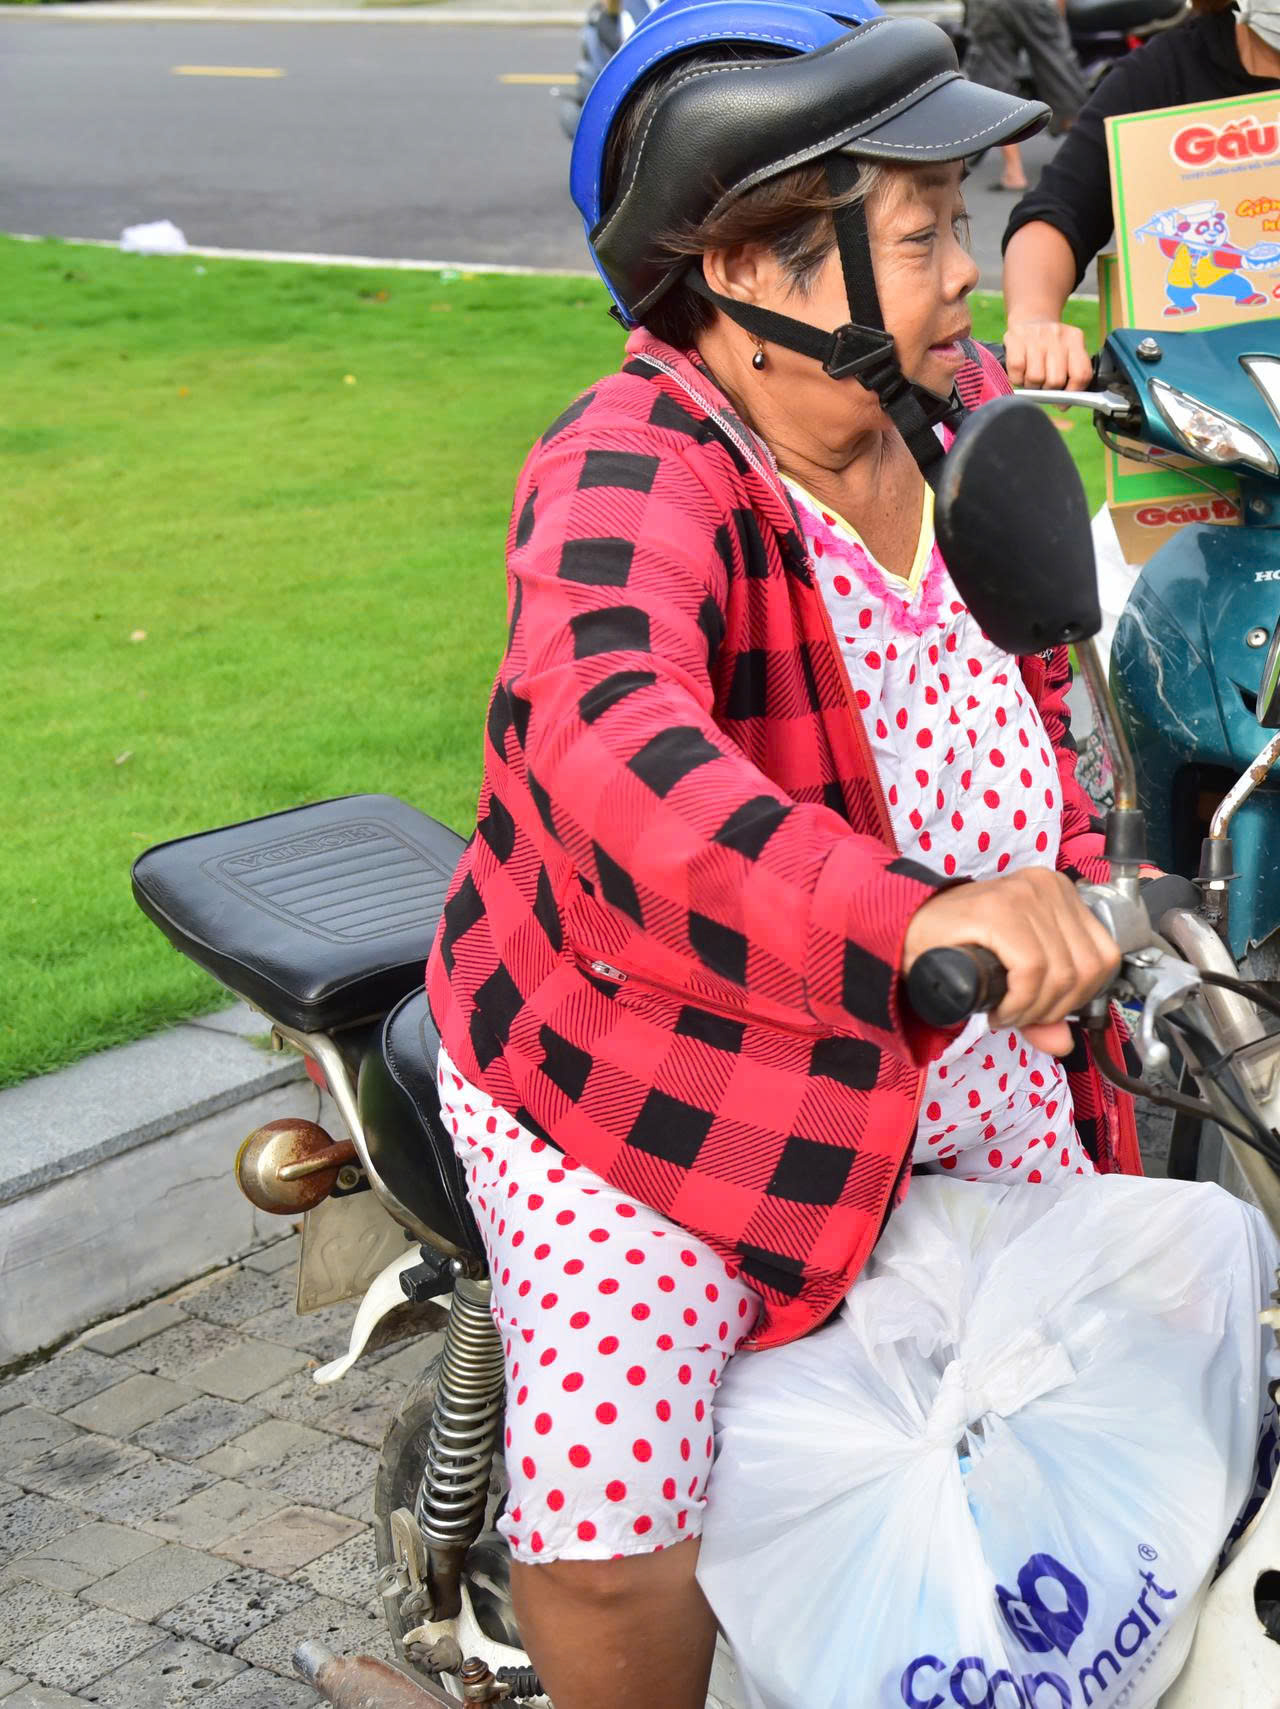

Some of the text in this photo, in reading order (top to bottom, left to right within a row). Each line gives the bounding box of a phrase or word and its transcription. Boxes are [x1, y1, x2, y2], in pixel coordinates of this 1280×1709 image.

[1174, 119, 1279, 166] Gấu
[1136, 500, 1239, 526] Gấu Đ
[230, 827, 378, 868] HONDA
